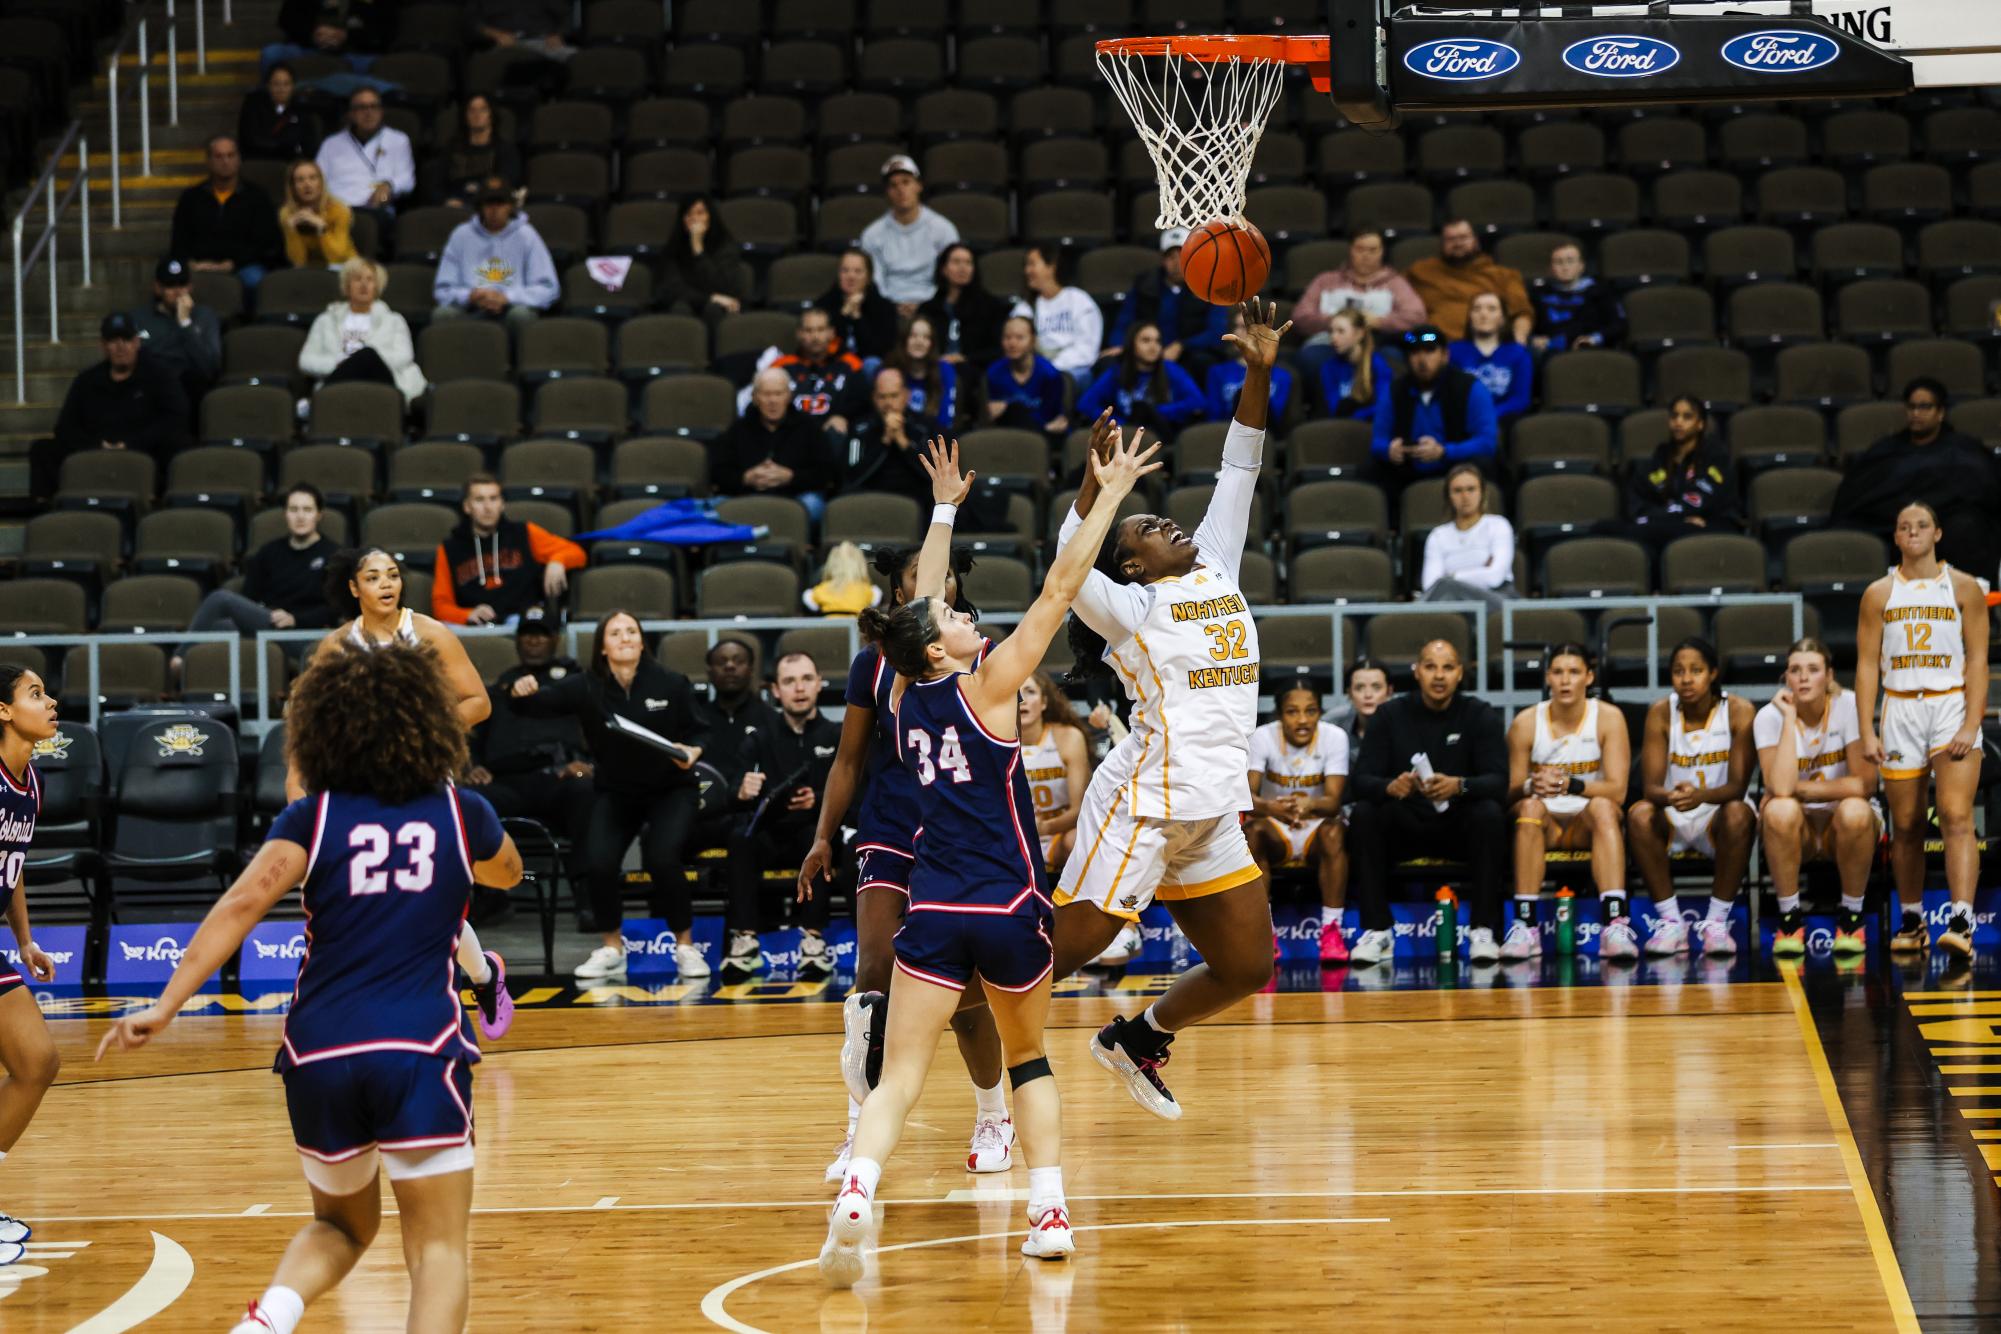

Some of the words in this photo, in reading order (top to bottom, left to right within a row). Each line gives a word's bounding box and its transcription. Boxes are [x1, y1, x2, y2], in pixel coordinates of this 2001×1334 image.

[1425, 40, 1496, 73] Ford
[1586, 36, 1655, 70] Ford
[1744, 32, 1815, 64] Ford
[1203, 619, 1249, 661] 32
[1903, 623, 1932, 651] 12
[908, 725, 972, 786] 34
[348, 820, 437, 896] 23
